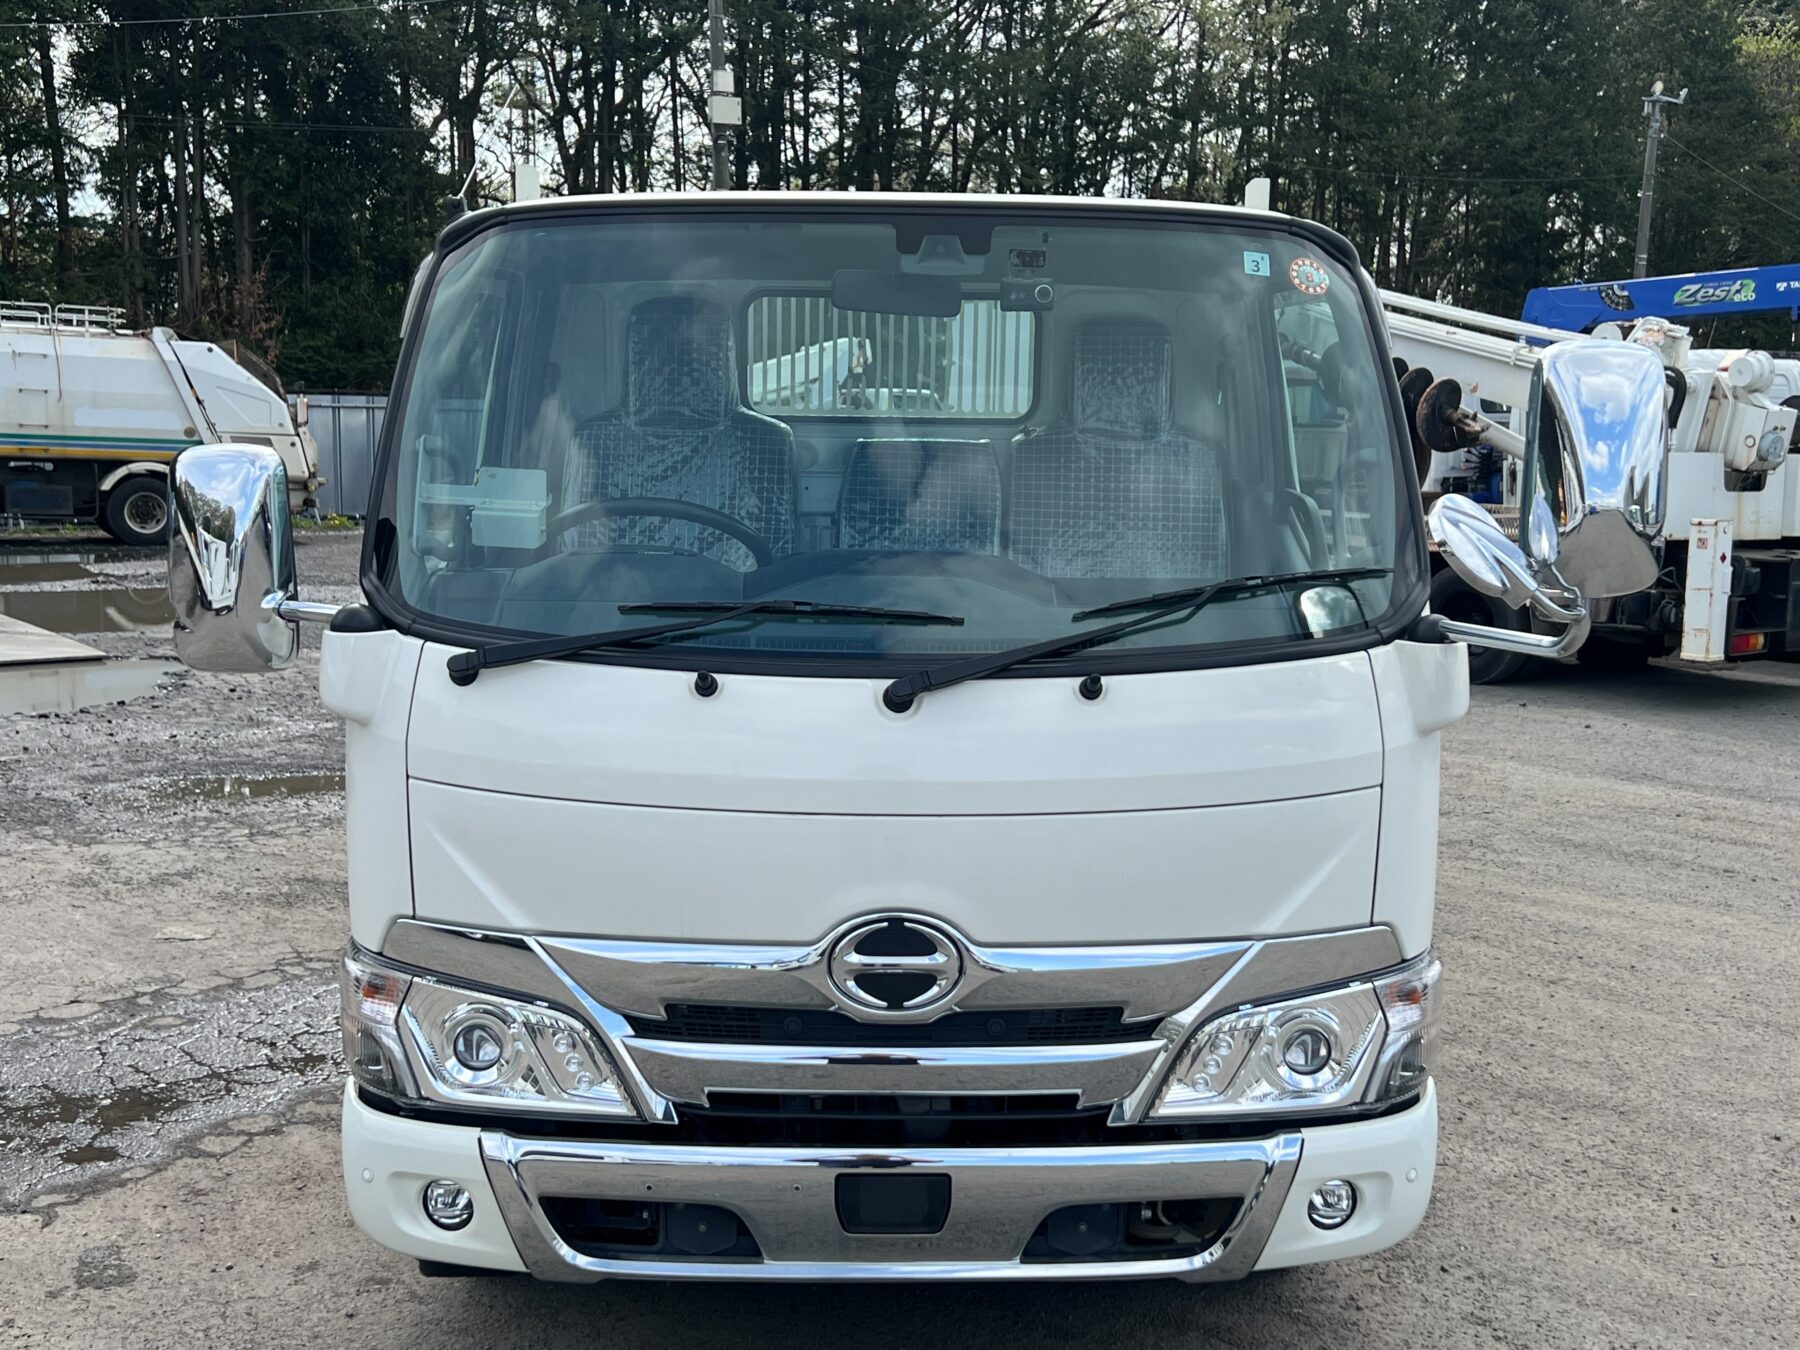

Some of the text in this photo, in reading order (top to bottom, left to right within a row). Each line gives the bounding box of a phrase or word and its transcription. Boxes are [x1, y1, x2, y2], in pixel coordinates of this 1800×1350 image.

[1251, 259, 1260, 273] 3
[1674, 280, 1742, 304] Zest
[1734, 292, 1756, 302] eco
